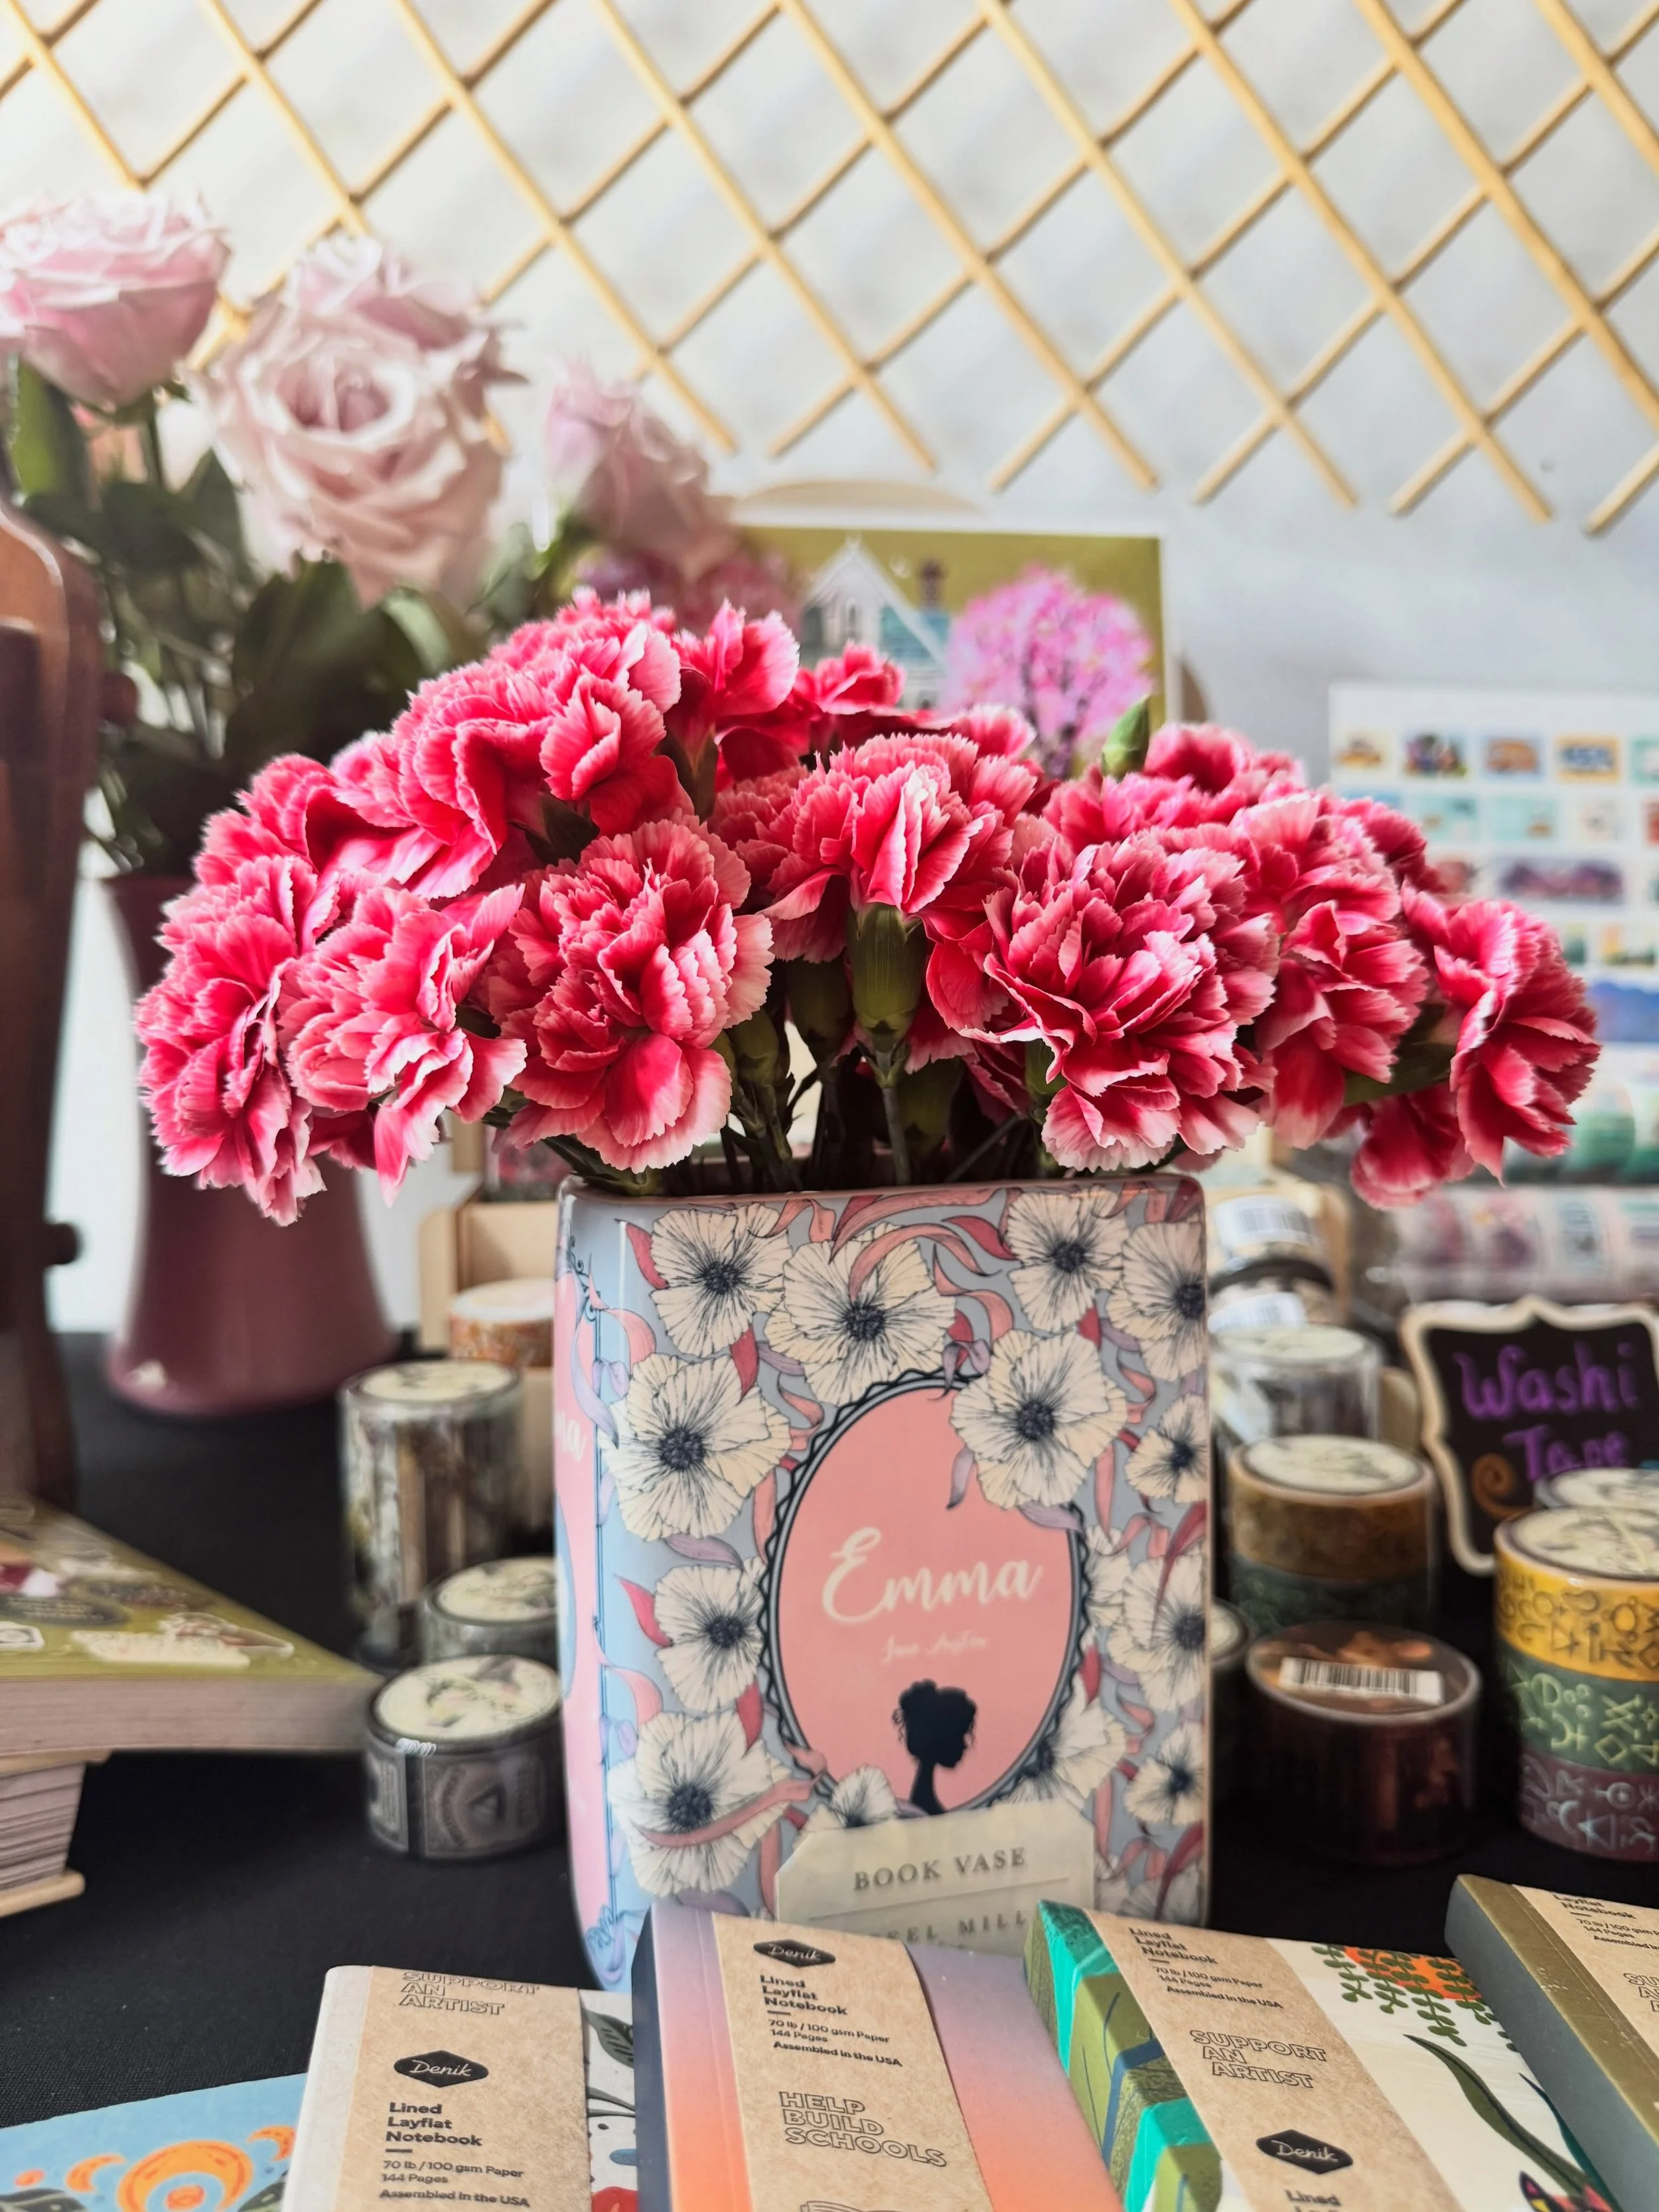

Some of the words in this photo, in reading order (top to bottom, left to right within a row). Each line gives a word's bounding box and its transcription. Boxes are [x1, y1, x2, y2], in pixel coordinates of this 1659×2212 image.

[1451, 1339, 1640, 1420] Washi
[821, 1527, 1043, 1624] Emma
[853, 1860, 941, 1891] BOOK
[954, 1848, 1025, 1874] VASE
[1561, 1902, 1636, 1919] Notebook
[1129, 1927, 1172, 1940] Lined
[1593, 1935, 1649, 1949] Assembled
[767, 1943, 822, 1960] Denik
[1134, 1936, 1187, 1951] Layflat
[1141, 1946, 1218, 1964] Notebook
[403, 1970, 540, 1994] SUPPORT
[760, 1974, 806, 1988] Lined
[1189, 1971, 1208, 1980] 100
[1232, 1978, 1263, 1988] Paper
[401, 1982, 446, 1996] AN
[762, 1985, 818, 2000] Layflat
[1167, 1986, 1227, 2000] Assembled
[1237, 1995, 1256, 2005] the
[1256, 1999, 1284, 2010] USA
[399, 1994, 505, 2015] ARTIST
[764, 1996, 848, 2015] Notebook
[770, 2029, 791, 2037] 144
[794, 2031, 828, 2043] Pages
[808, 2023, 828, 2033] 100
[831, 2028, 855, 2037] gsm
[857, 2031, 890, 2043] Paper
[774, 2041, 838, 2056] Assembled
[853, 2051, 873, 2061] the
[875, 2055, 902, 2067] USA
[1190, 2029, 1327, 2062] SUPPORT
[1202, 2045, 1248, 2065] AN
[409, 2059, 472, 2077] Denik
[1212, 2061, 1315, 2089] ARTIST
[389, 2102, 443, 2114] Lined
[779, 2091, 865, 2115] HELP
[388, 2116, 453, 2130] Layflat
[783, 2108, 884, 2137] BUILD
[386, 2131, 483, 2146] Notebook
[784, 2126, 947, 2168] SCHOOLS
[1271, 2140, 1338, 2163] Denik
[383, 2160, 401, 2169] 70
[404, 2160, 417, 2170] lb
[428, 2162, 453, 2171] 100
[455, 2164, 482, 2174] gsm
[486, 2166, 524, 2177] Paper
[382, 2174, 405, 2182] 144
[408, 2174, 449, 2184] Pages
[380, 2189, 456, 2200] Assembled
[474, 2192, 497, 2203] the
[500, 2195, 530, 2207] USA
[1285, 2189, 1342, 2207] Lined
